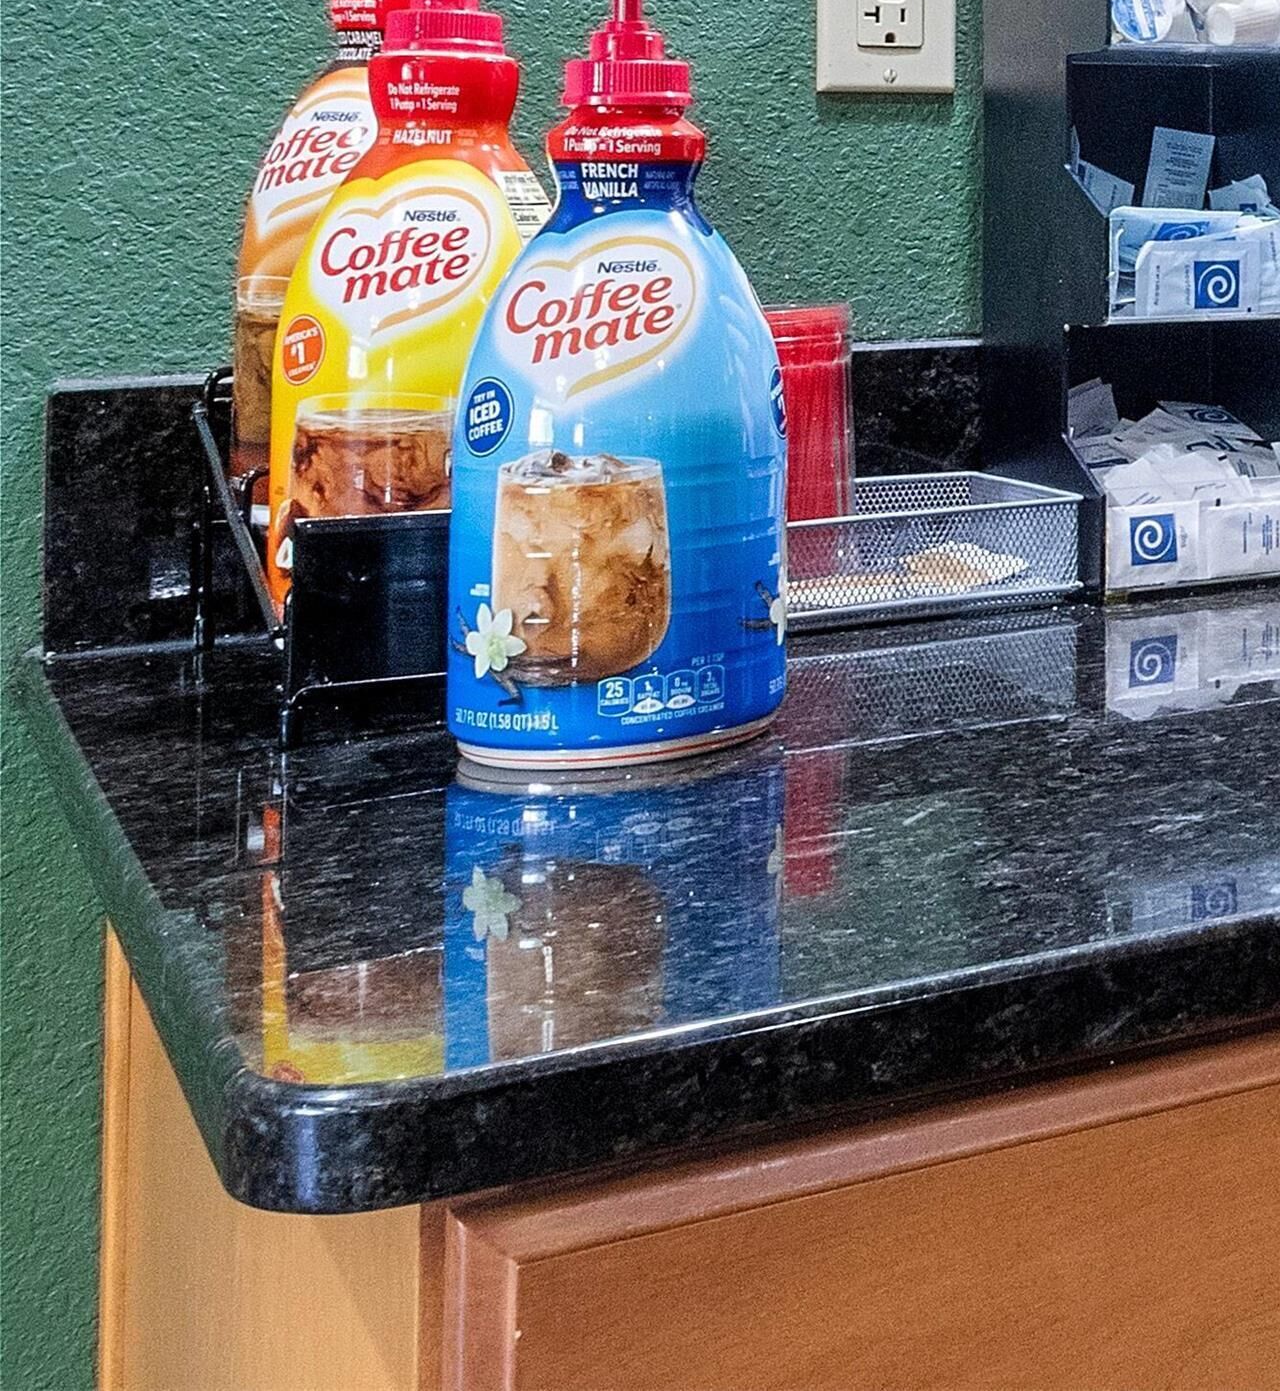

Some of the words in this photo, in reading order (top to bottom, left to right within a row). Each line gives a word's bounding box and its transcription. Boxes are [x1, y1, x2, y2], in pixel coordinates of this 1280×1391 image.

[387, 83, 398, 95] Do
[399, 83, 413, 96] Not
[414, 83, 460, 100] Refrigerate
[426, 99, 458, 113] Serving
[392, 129, 453, 144] HAZELNUT
[264, 126, 369, 166] offee
[615, 139, 661, 155] Serving
[257, 151, 360, 194] mate
[580, 162, 639, 179] FRENCH
[582, 181, 639, 198] VANILLA
[403, 209, 457, 222] Nestlé
[320, 225, 470, 277] Coffee
[597, 260, 658, 274] Nestlé
[342, 253, 470, 304] mate
[506, 276, 673, 334] Coffee
[532, 305, 675, 365] mate
[469, 400, 501, 426] ICED
[468, 419, 504, 442] COFFEE
[605, 681, 624, 698] 25
[467, 710, 476, 726] FL
[476, 711, 488, 727] OZ
[489, 711, 511, 730] (1.58
[620, 711, 673, 726] CONCENTRATED
